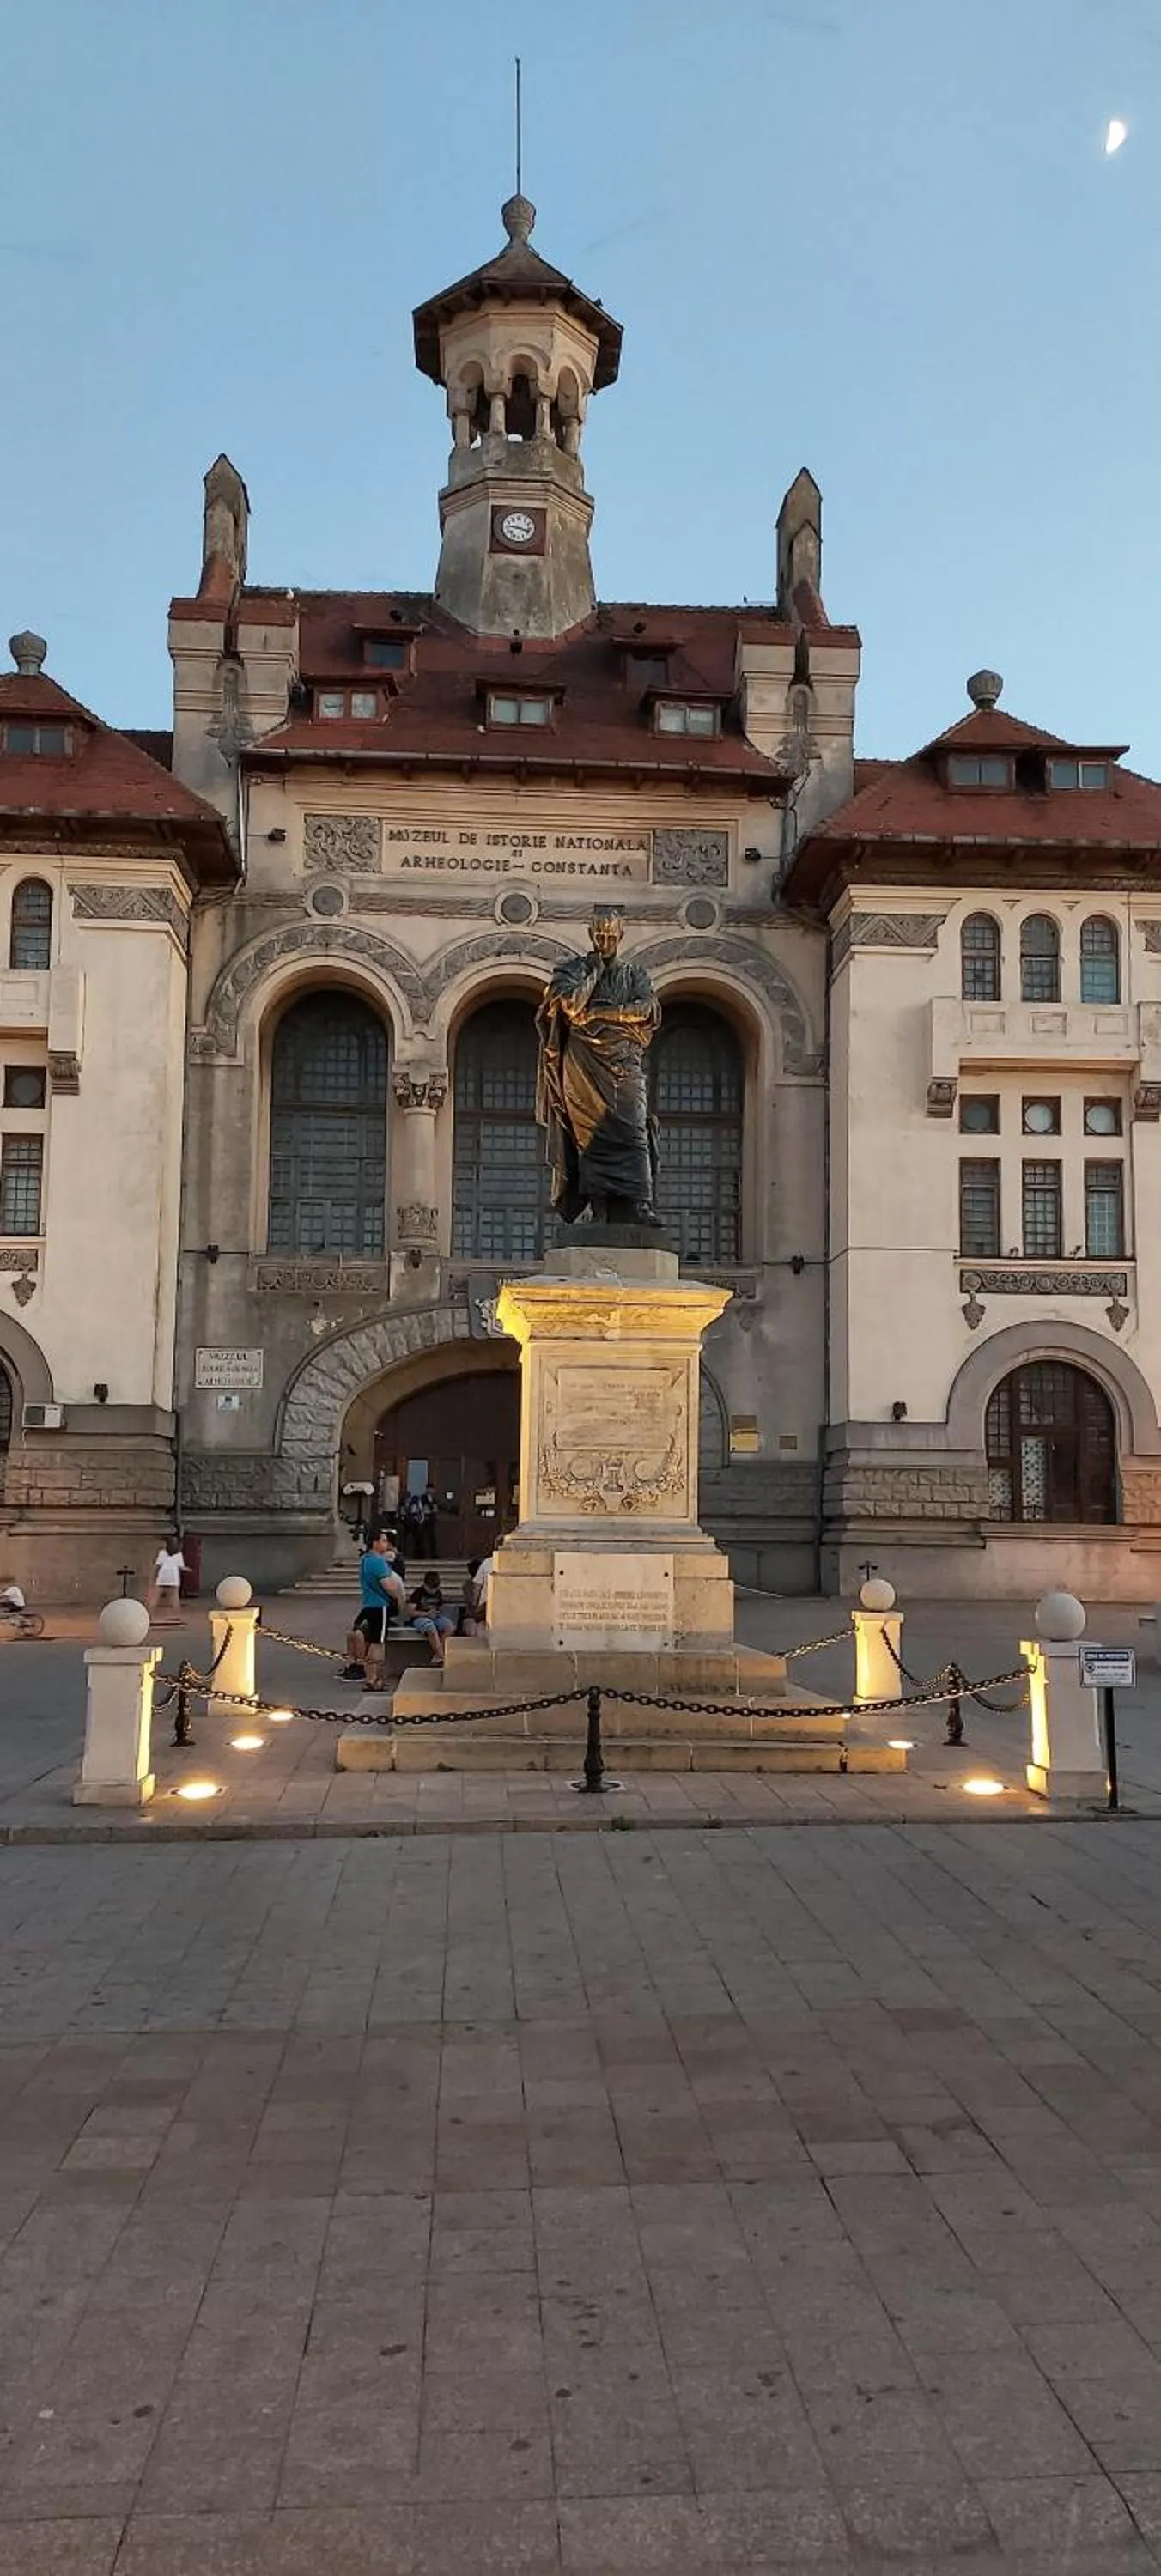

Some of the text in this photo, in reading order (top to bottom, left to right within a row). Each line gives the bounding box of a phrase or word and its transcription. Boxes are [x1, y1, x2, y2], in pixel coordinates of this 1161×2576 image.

[459, 832, 478, 846] DE
[486, 834, 547, 848] ISTORIE
[556, 836, 647, 850] NATIONALA
[532, 861, 632, 876] CONSTANTA
